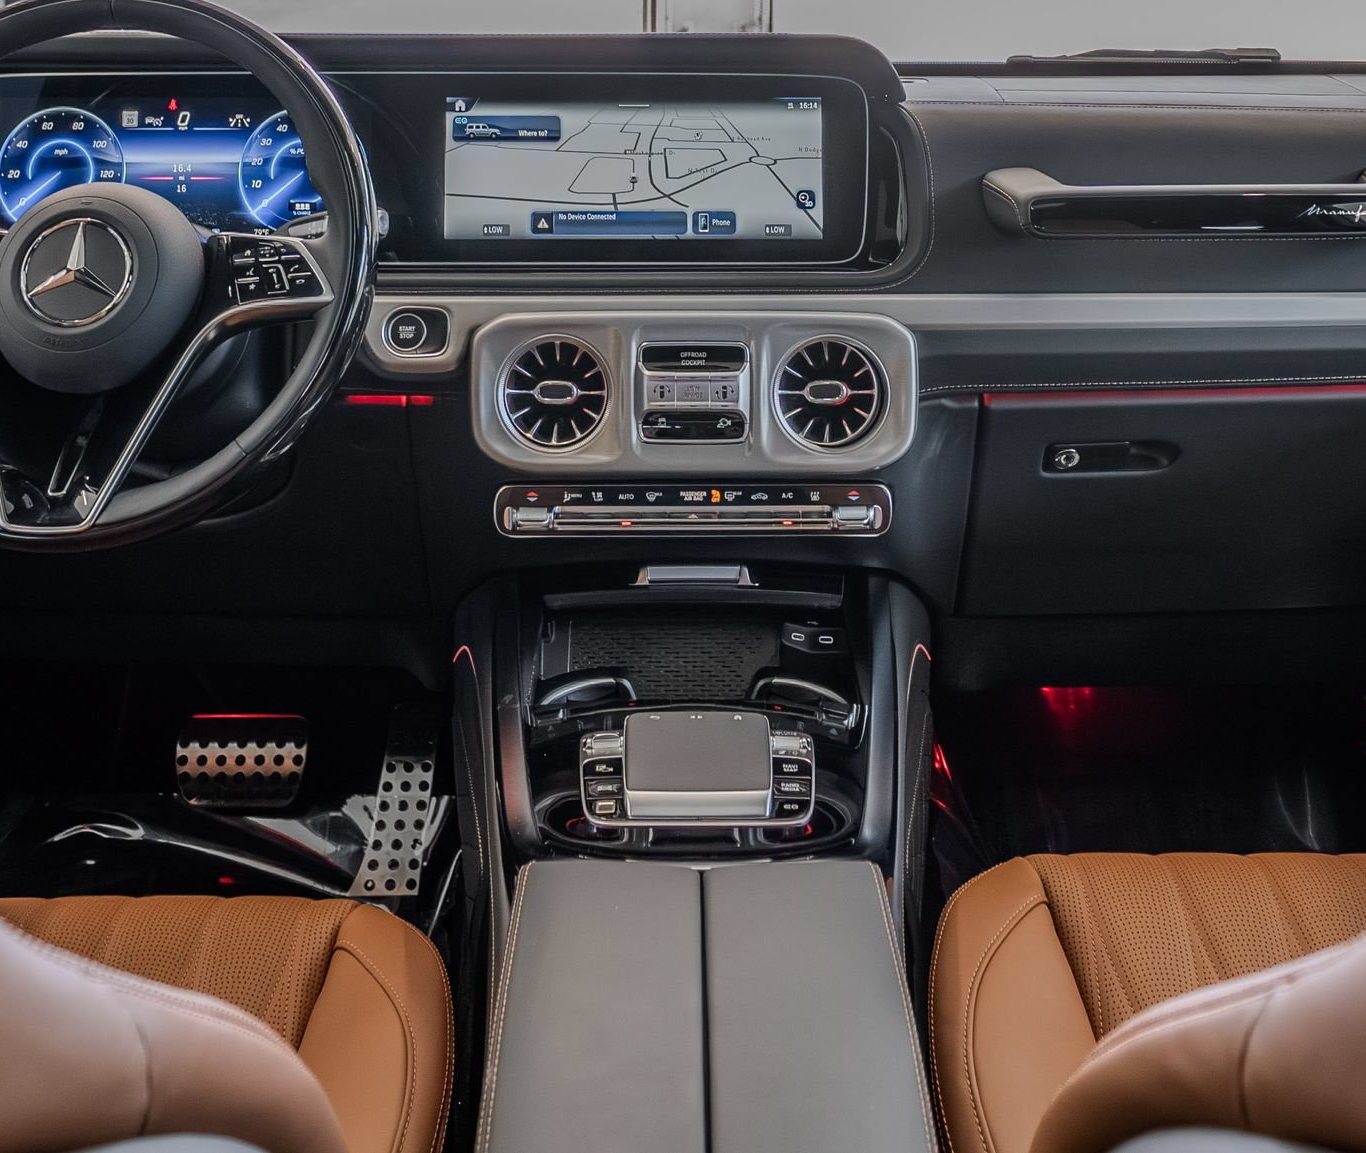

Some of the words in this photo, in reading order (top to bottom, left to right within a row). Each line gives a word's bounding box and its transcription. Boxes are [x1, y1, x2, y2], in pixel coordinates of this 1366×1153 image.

[41, 122, 53, 130] 60
[72, 122, 84, 130] 80
[277, 124, 288, 132] 40
[16, 140, 28, 149] 40
[92, 140, 107, 148] 100
[260, 138, 272, 146] 30
[54, 148, 68, 156] mph
[251, 158, 263, 166] 20
[173, 164, 192, 173] 16.4
[7, 169, 21, 179] 20
[100, 170, 114, 178] 120
[251, 180, 262, 188] 10
[176, 184, 187, 193] 16
[558, 212, 567, 221] No
[568, 212, 585, 221] Device
[586, 212, 617, 221] Connected
[712, 218, 731, 227] Phone
[488, 226, 503, 234] LOW
[770, 226, 785, 234] LOW
